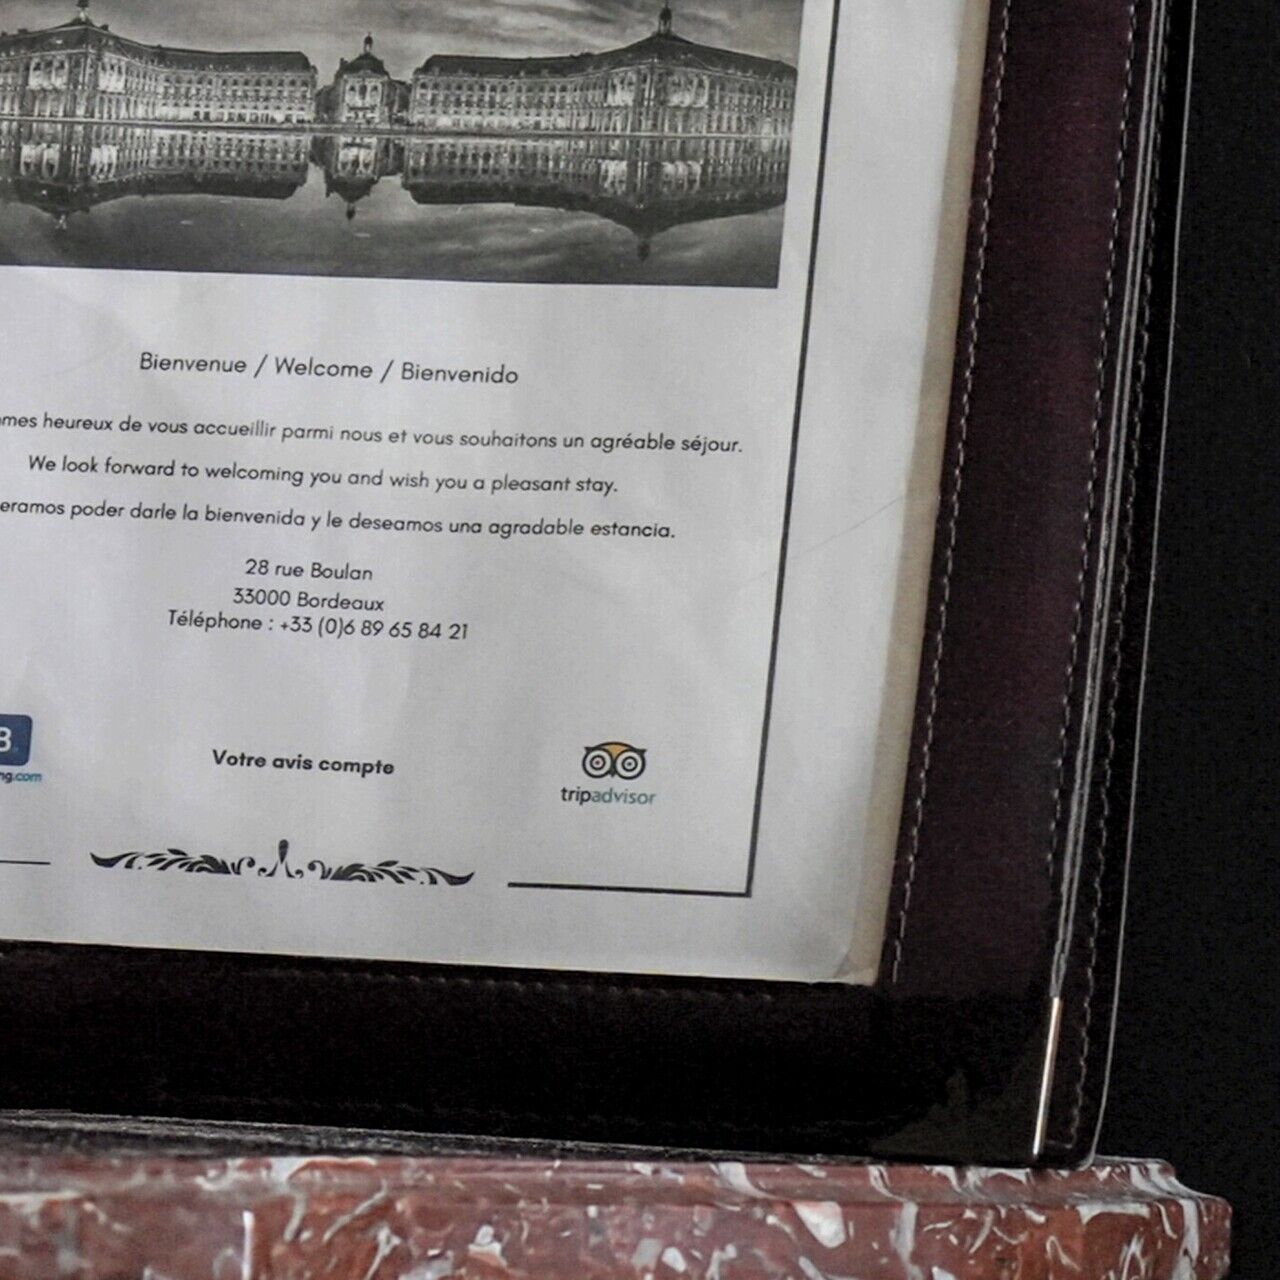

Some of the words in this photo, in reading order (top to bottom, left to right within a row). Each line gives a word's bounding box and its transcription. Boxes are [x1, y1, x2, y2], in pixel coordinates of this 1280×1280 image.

[139, 350, 248, 374] Bienvenue
[274, 356, 374, 379] Welcome
[400, 361, 520, 385] Bienvenido
[42, 411, 114, 432] heureux
[117, 414, 143, 433] de
[147, 421, 189, 435] vous
[192, 419, 277, 438] accueillir
[280, 425, 334, 443] parmi
[339, 429, 383, 444] nous
[387, 429, 408, 444] et
[412, 432, 454, 446] vous
[458, 429, 558, 449] souhaitons
[562, 436, 585, 449] un
[589, 431, 676, 454] agréable
[680, 434, 743, 457] séjour.
[28, 454, 57, 472] We
[61, 454, 99, 474] look
[103, 455, 176, 477] forward
[180, 462, 200, 478] to
[204, 461, 305, 488] welcoming
[308, 471, 343, 489] you
[347, 468, 384, 487] and
[388, 470, 430, 488] wish
[434, 477, 468, 494] you
[472, 478, 486, 491] a
[490, 473, 572, 496] pleasant
[575, 477, 619, 498] stay.
[69, 499, 126, 521] poder
[129, 501, 178, 521] darle
[181, 502, 199, 522] la
[204, 503, 306, 527] bienvenida
[310, 515, 322, 532] y
[325, 509, 344, 529] le
[347, 511, 444, 533] deseamos
[448, 521, 483, 535] una
[487, 516, 585, 540] agradable
[589, 521, 676, 539] estancia.
[244, 557, 270, 576] 28
[274, 564, 305, 578] rue
[310, 561, 374, 581] Boulan
[232, 586, 292, 607] 33000
[296, 590, 385, 612] Bordeaux
[167, 608, 264, 633] Téléphone
[280, 615, 313, 634] +33
[317, 615, 356, 640] (0)6
[360, 619, 385, 637] 89
[387, 621, 413, 639] 65
[417, 621, 442, 640] 84
[448, 622, 469, 641] 21
[211, 748, 268, 769] Votre
[271, 753, 314, 771] avis
[317, 759, 396, 779] compte
[560, 785, 657, 807] tripadvisor
